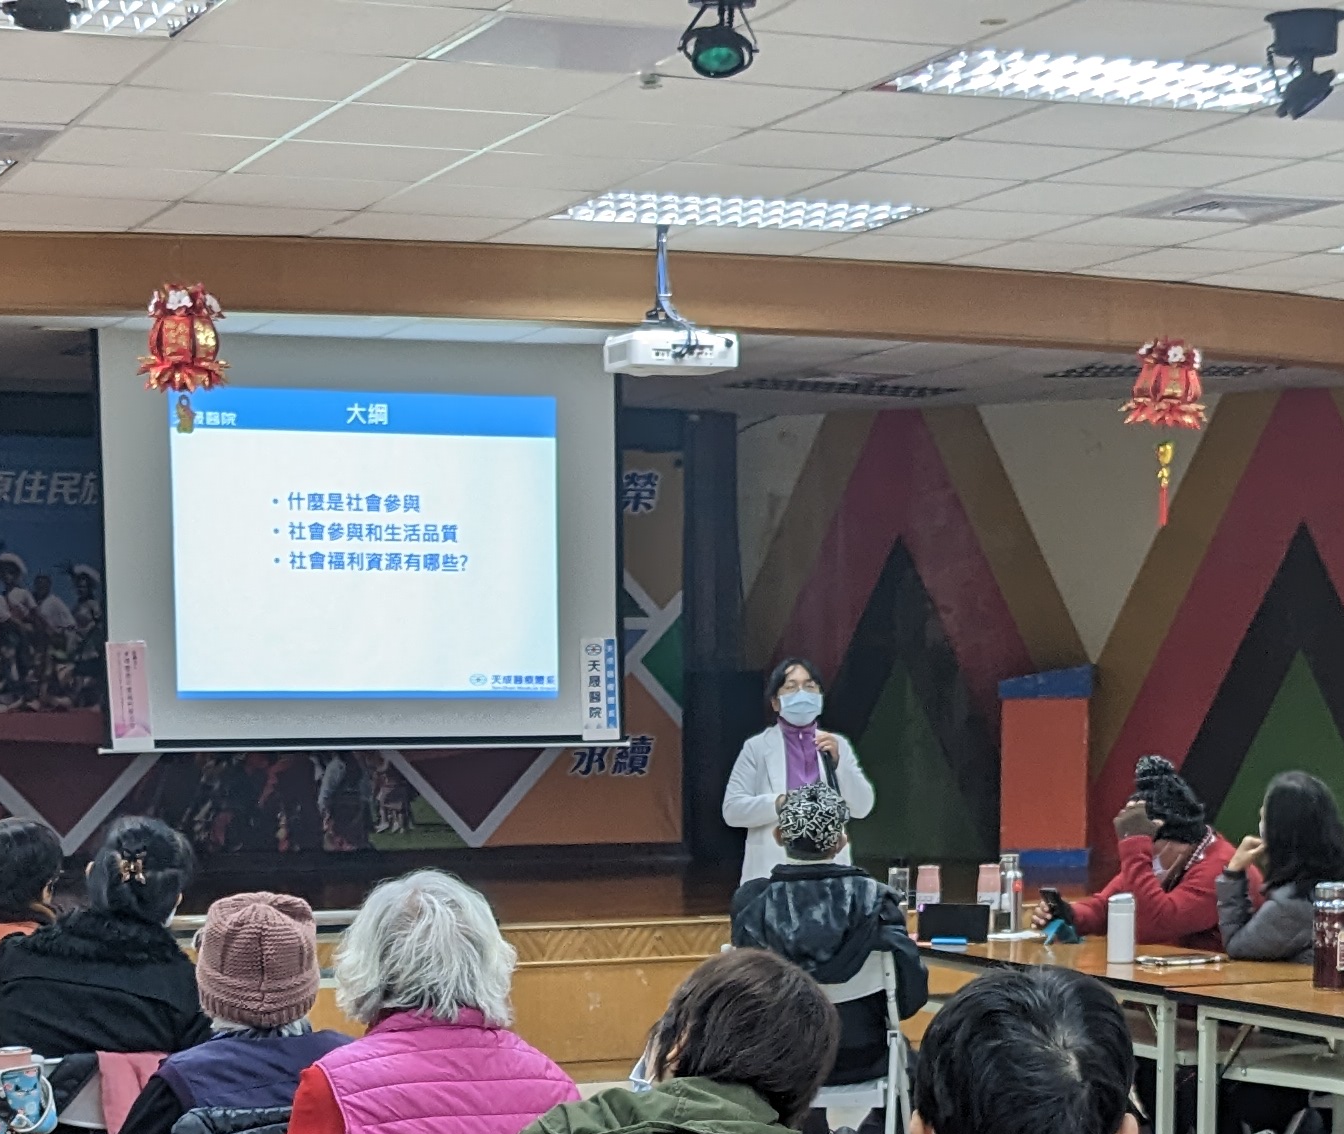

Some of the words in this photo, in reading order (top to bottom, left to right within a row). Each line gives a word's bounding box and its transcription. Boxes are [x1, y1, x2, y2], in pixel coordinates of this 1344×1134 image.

[172, 410, 237, 426] 晟醫院
[345, 403, 389, 425] 大綱
[287, 492, 421, 513] 什麼是社會參與
[288, 522, 459, 543] 社會參與和生活品質
[289, 551, 469, 572] 社會福利資源有哪些?
